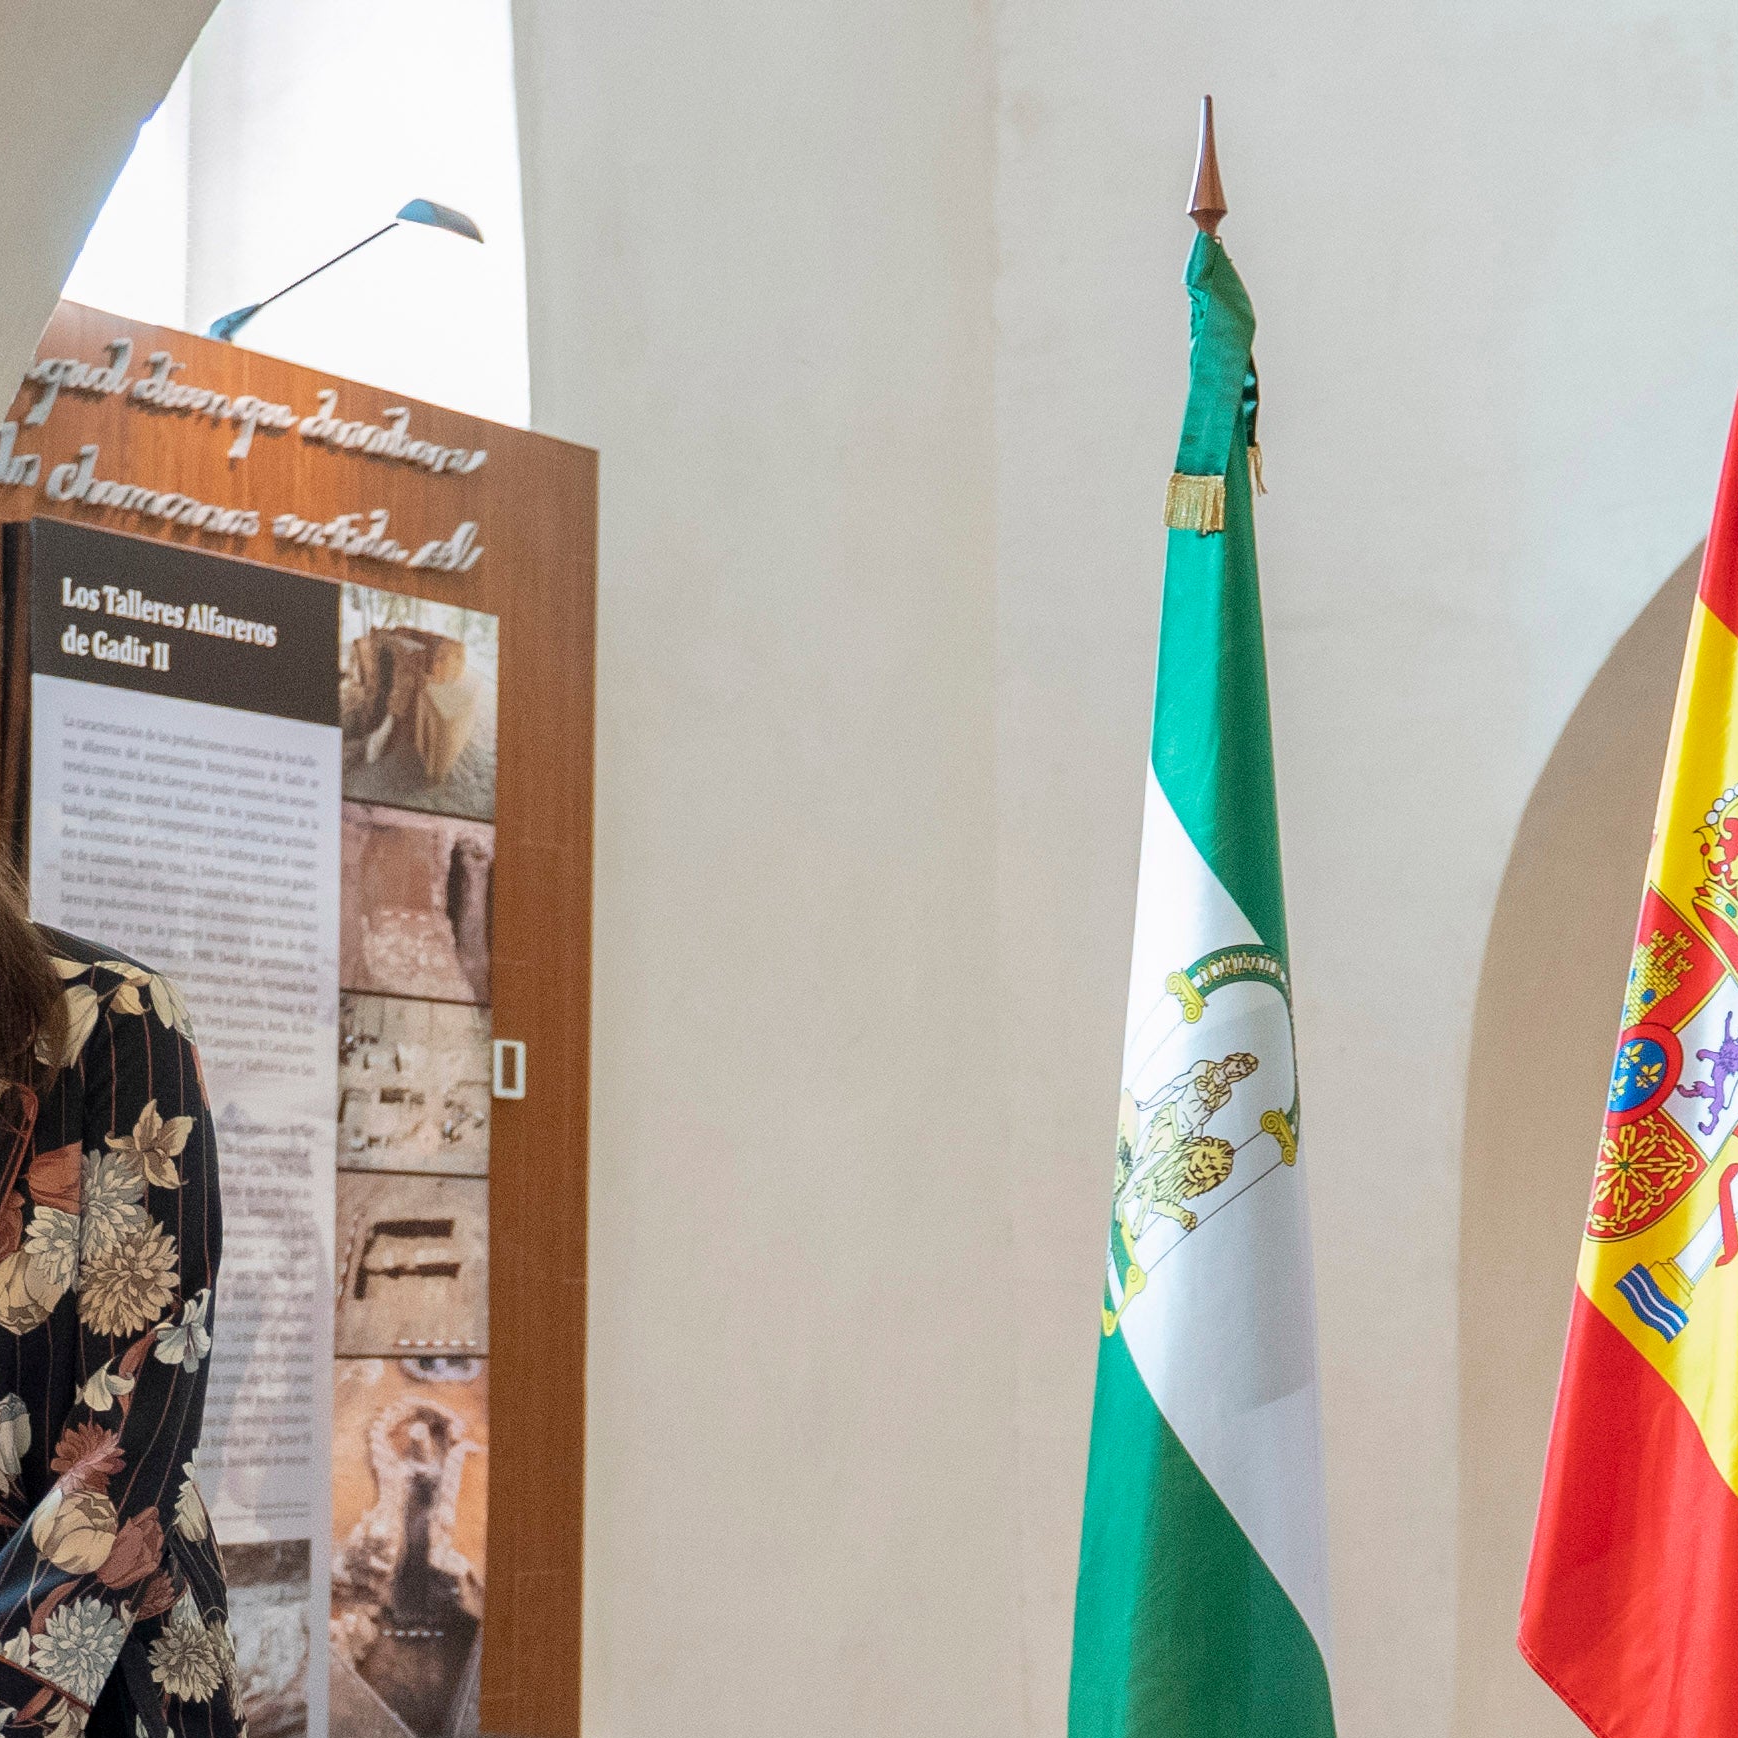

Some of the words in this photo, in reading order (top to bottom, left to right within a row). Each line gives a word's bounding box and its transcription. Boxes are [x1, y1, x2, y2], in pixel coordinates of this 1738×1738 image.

[62, 577, 101, 611] Los
[102, 585, 185, 628] Talleres
[185, 603, 278, 648] Alfareros
[61, 624, 90, 656] de
[91, 630, 150, 667] Gadir
[152, 641, 170, 672] II
